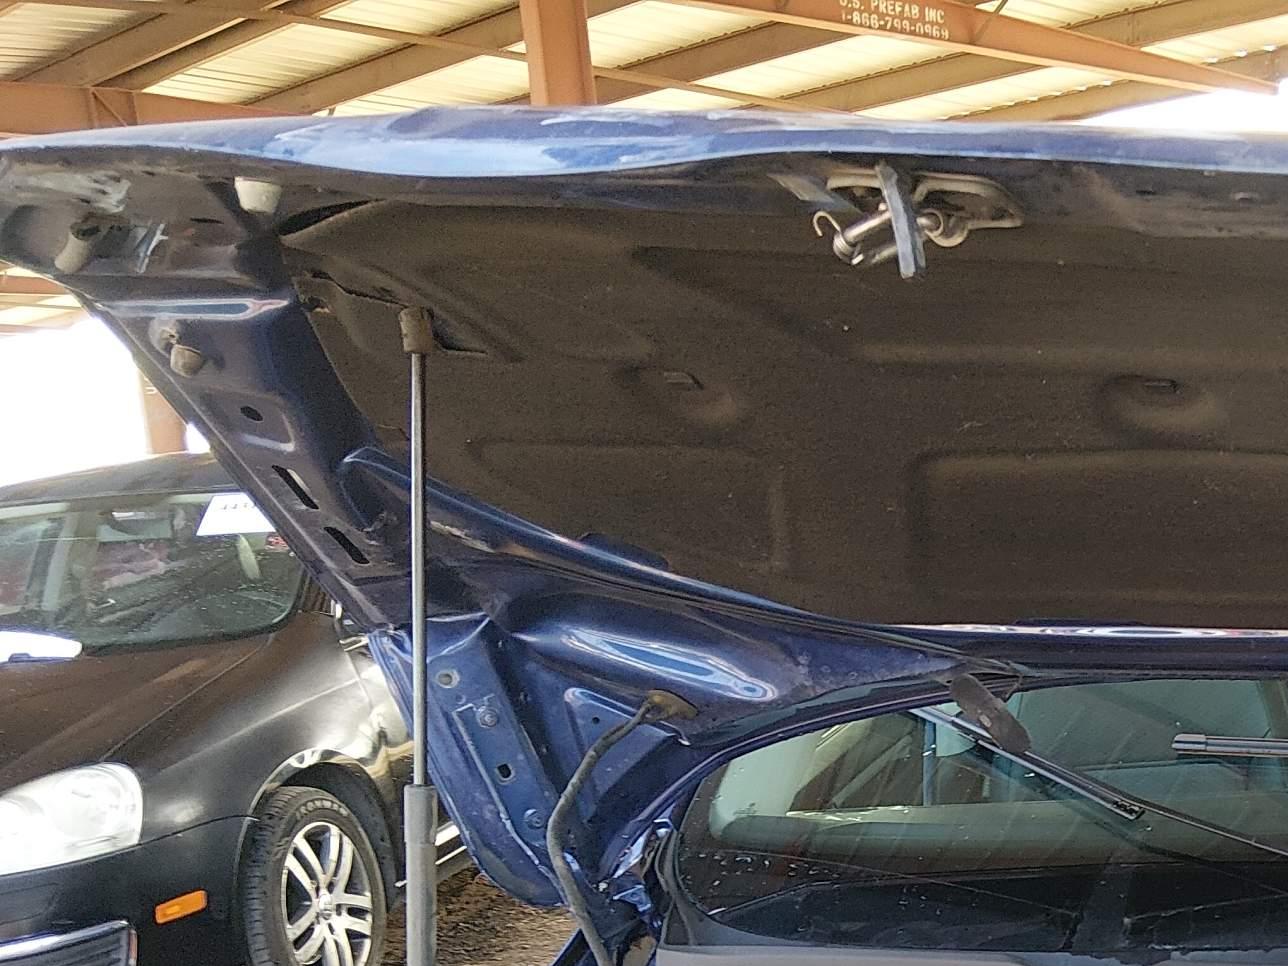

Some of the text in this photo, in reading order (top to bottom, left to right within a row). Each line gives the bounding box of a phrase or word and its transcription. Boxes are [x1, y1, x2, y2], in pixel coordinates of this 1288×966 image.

[871, 0, 920, 19] PREFAB
[925, 6, 945, 23] INC
[841, 10, 950, 40] 1-866-799-0969
